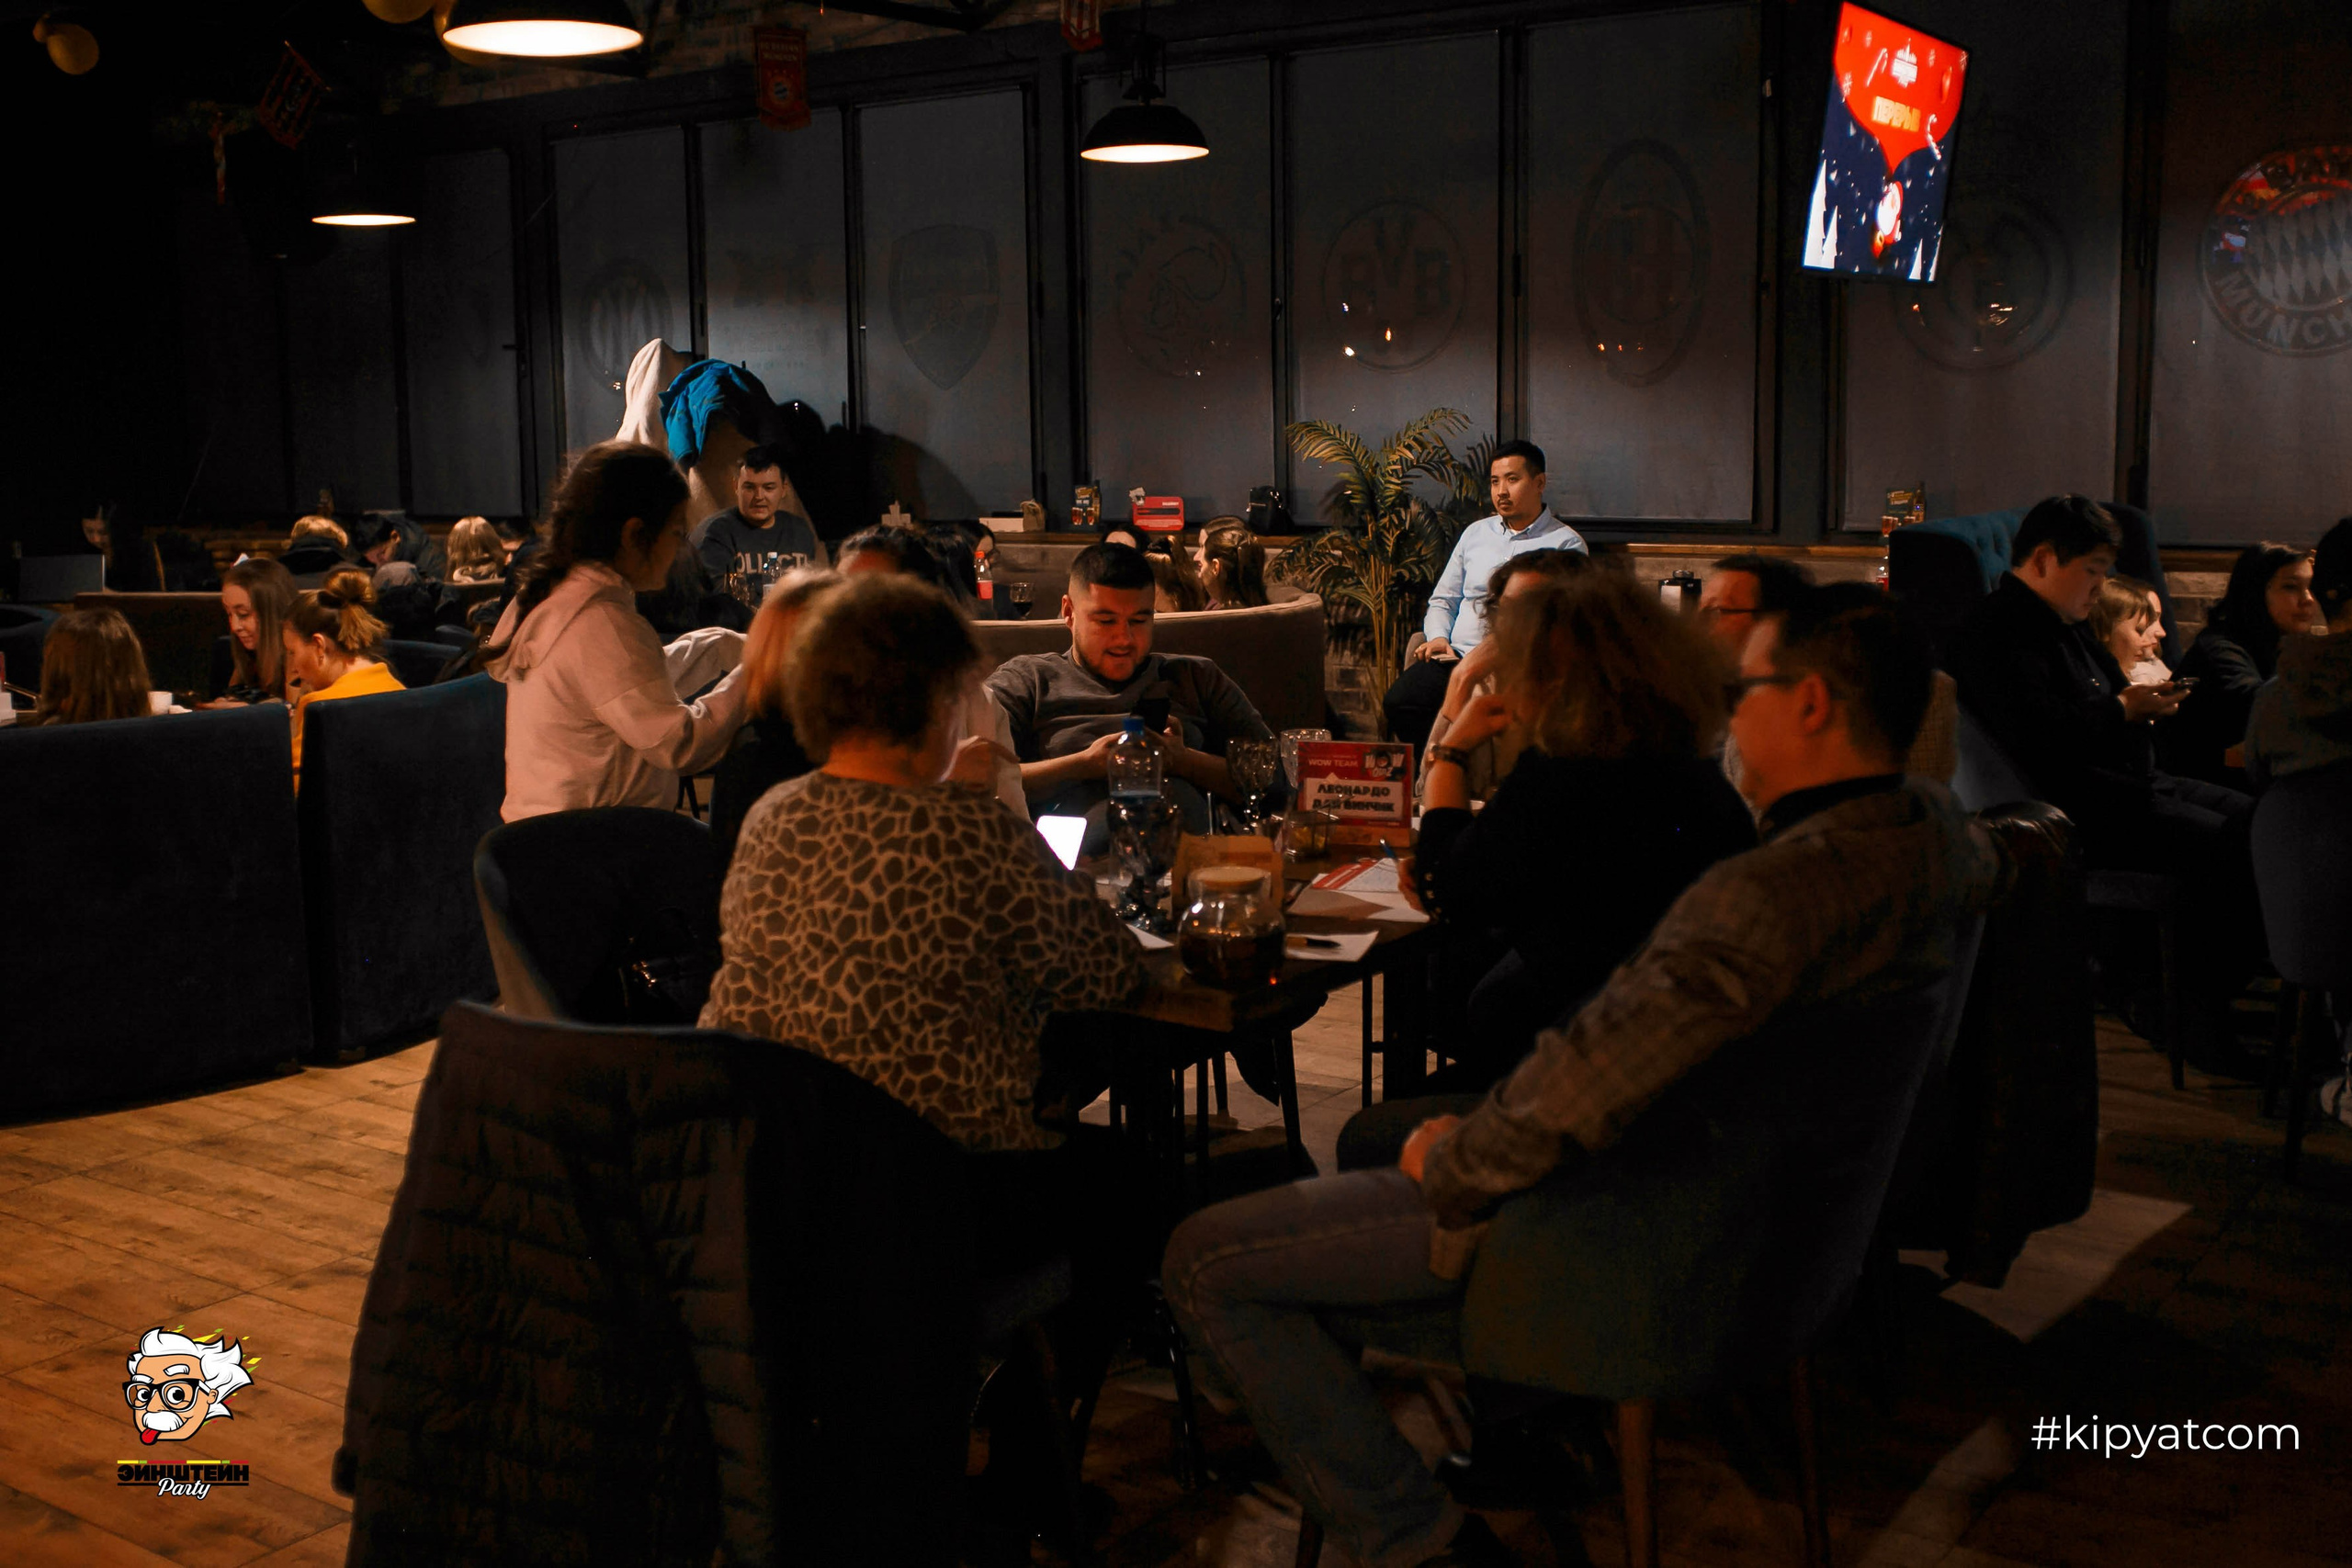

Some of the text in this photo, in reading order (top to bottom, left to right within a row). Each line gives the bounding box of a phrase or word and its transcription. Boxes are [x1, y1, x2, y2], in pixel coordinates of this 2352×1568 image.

[1308, 758, 1359, 768] WOW TEAM
[1317, 784, 1390, 797] ЛЕОНАРДО
